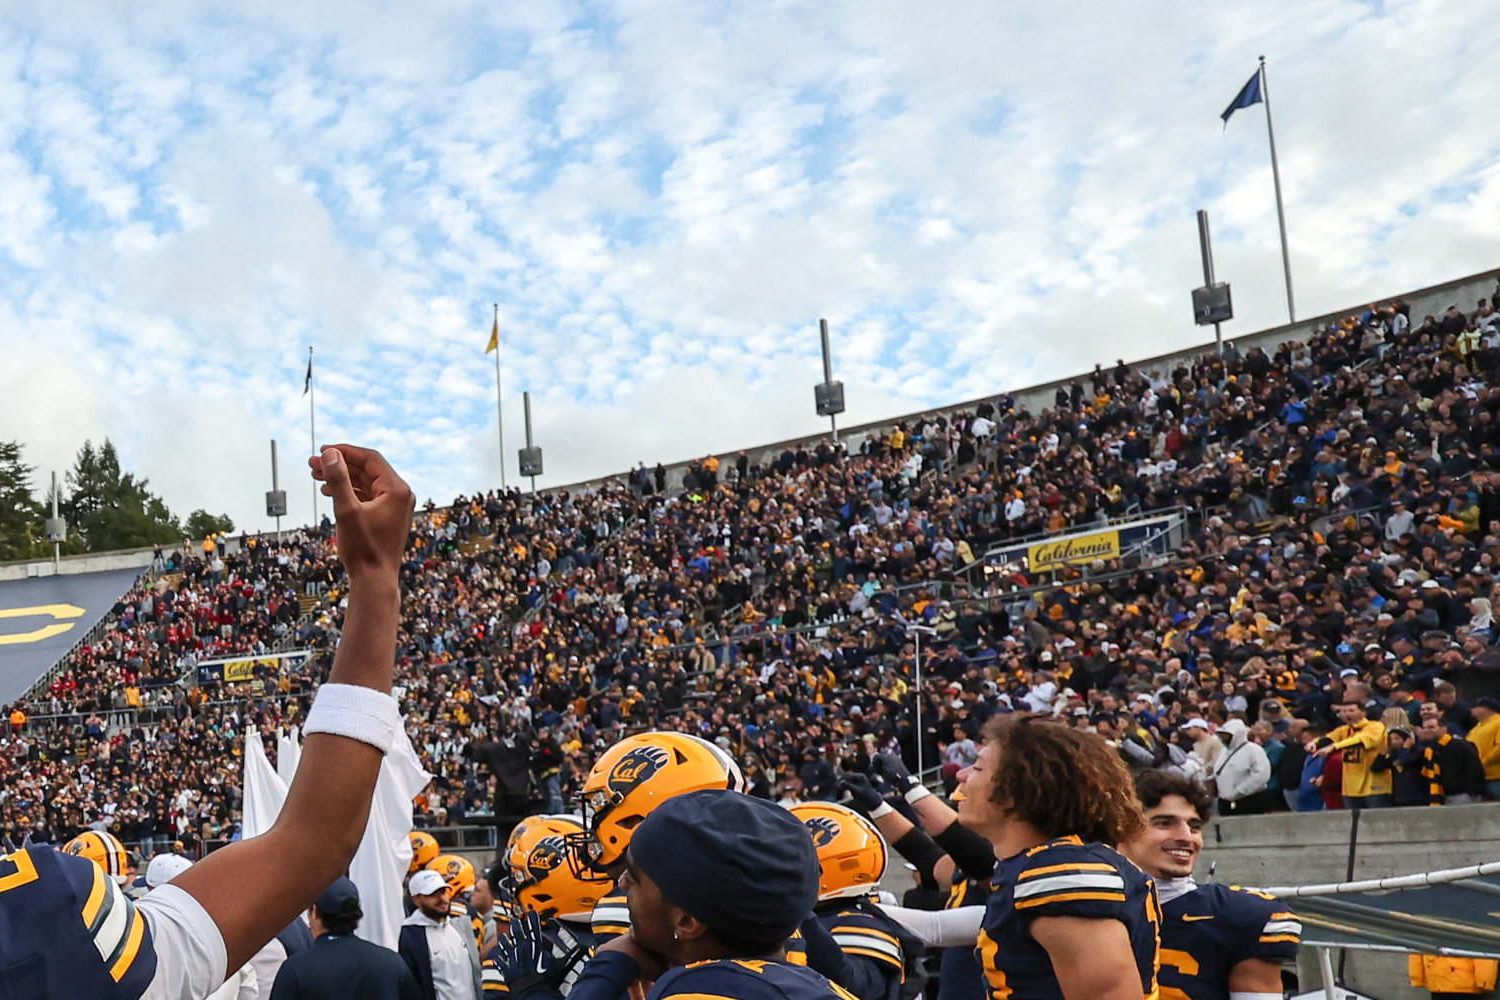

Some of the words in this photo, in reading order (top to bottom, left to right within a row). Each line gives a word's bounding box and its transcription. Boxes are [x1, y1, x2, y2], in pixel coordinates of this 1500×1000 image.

[1035, 537, 1113, 564] California
[612, 759, 648, 782] Cal
[530, 849, 557, 869] Cal
